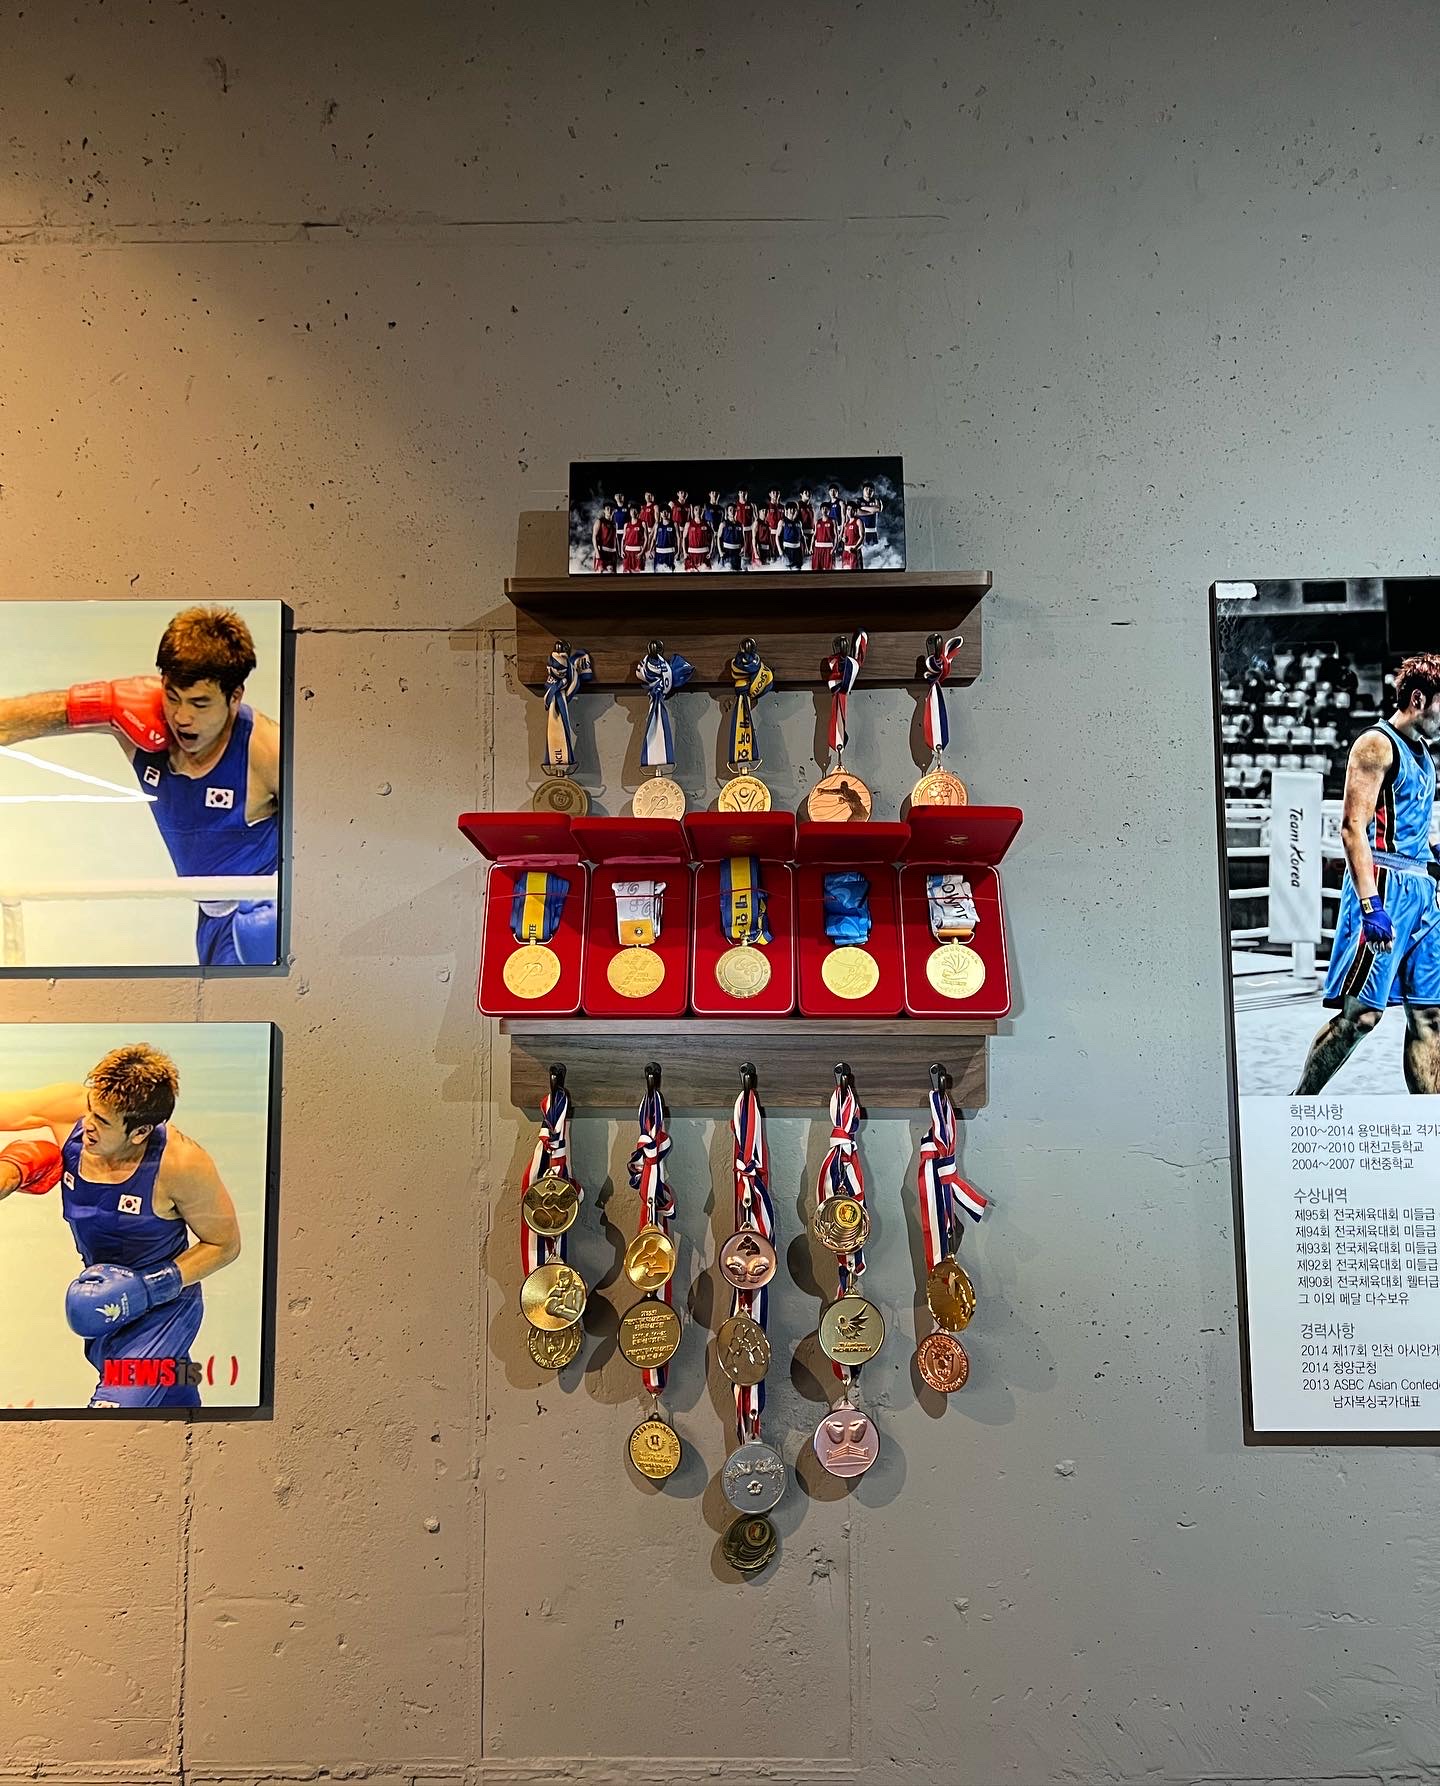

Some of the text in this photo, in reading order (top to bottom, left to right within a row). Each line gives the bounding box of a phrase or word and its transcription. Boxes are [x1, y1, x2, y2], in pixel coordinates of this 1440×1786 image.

[1290, 808, 1304, 888] Team Korea
[1290, 1104, 1343, 1120] 학력사항
[1291, 1124, 1440, 1137] 2010~2014 용인대학교 격기
[1291, 1140, 1424, 1154] 2007~2010 대천고등학교
[1291, 1157, 1414, 1170] 2004~2007 대천중학교
[1294, 1188, 1347, 1204] 수상내역
[1295, 1208, 1435, 1221] 제95회 전국체육대회 미들급
[1296, 1225, 1436, 1239] 제94회 전국체육대회 미들급
[1296, 1241, 1437, 1255] 제93회 전국체육대회 미들급
[1296, 1258, 1438, 1272] 제92회 전국체육대회 미들급
[1297, 1275, 1439, 1288] 제90회 전국체육대회 웰터급
[1299, 1292, 1409, 1306] 그 이외 메달 다수보유
[1301, 1323, 1355, 1339] 경력사항
[1301, 1345, 1327, 1356] 2014
[1332, 1344, 1367, 1357] 제17회
[1372, 1344, 1393, 1357] 인천
[1302, 1361, 1378, 1375] 2014 청양군청
[1303, 1379, 1330, 1391] 2013
[1334, 1379, 1364, 1391] ASBC
[1368, 1379, 1397, 1390] Asian
[1333, 1395, 1421, 1409] 남자복싱국가대표
